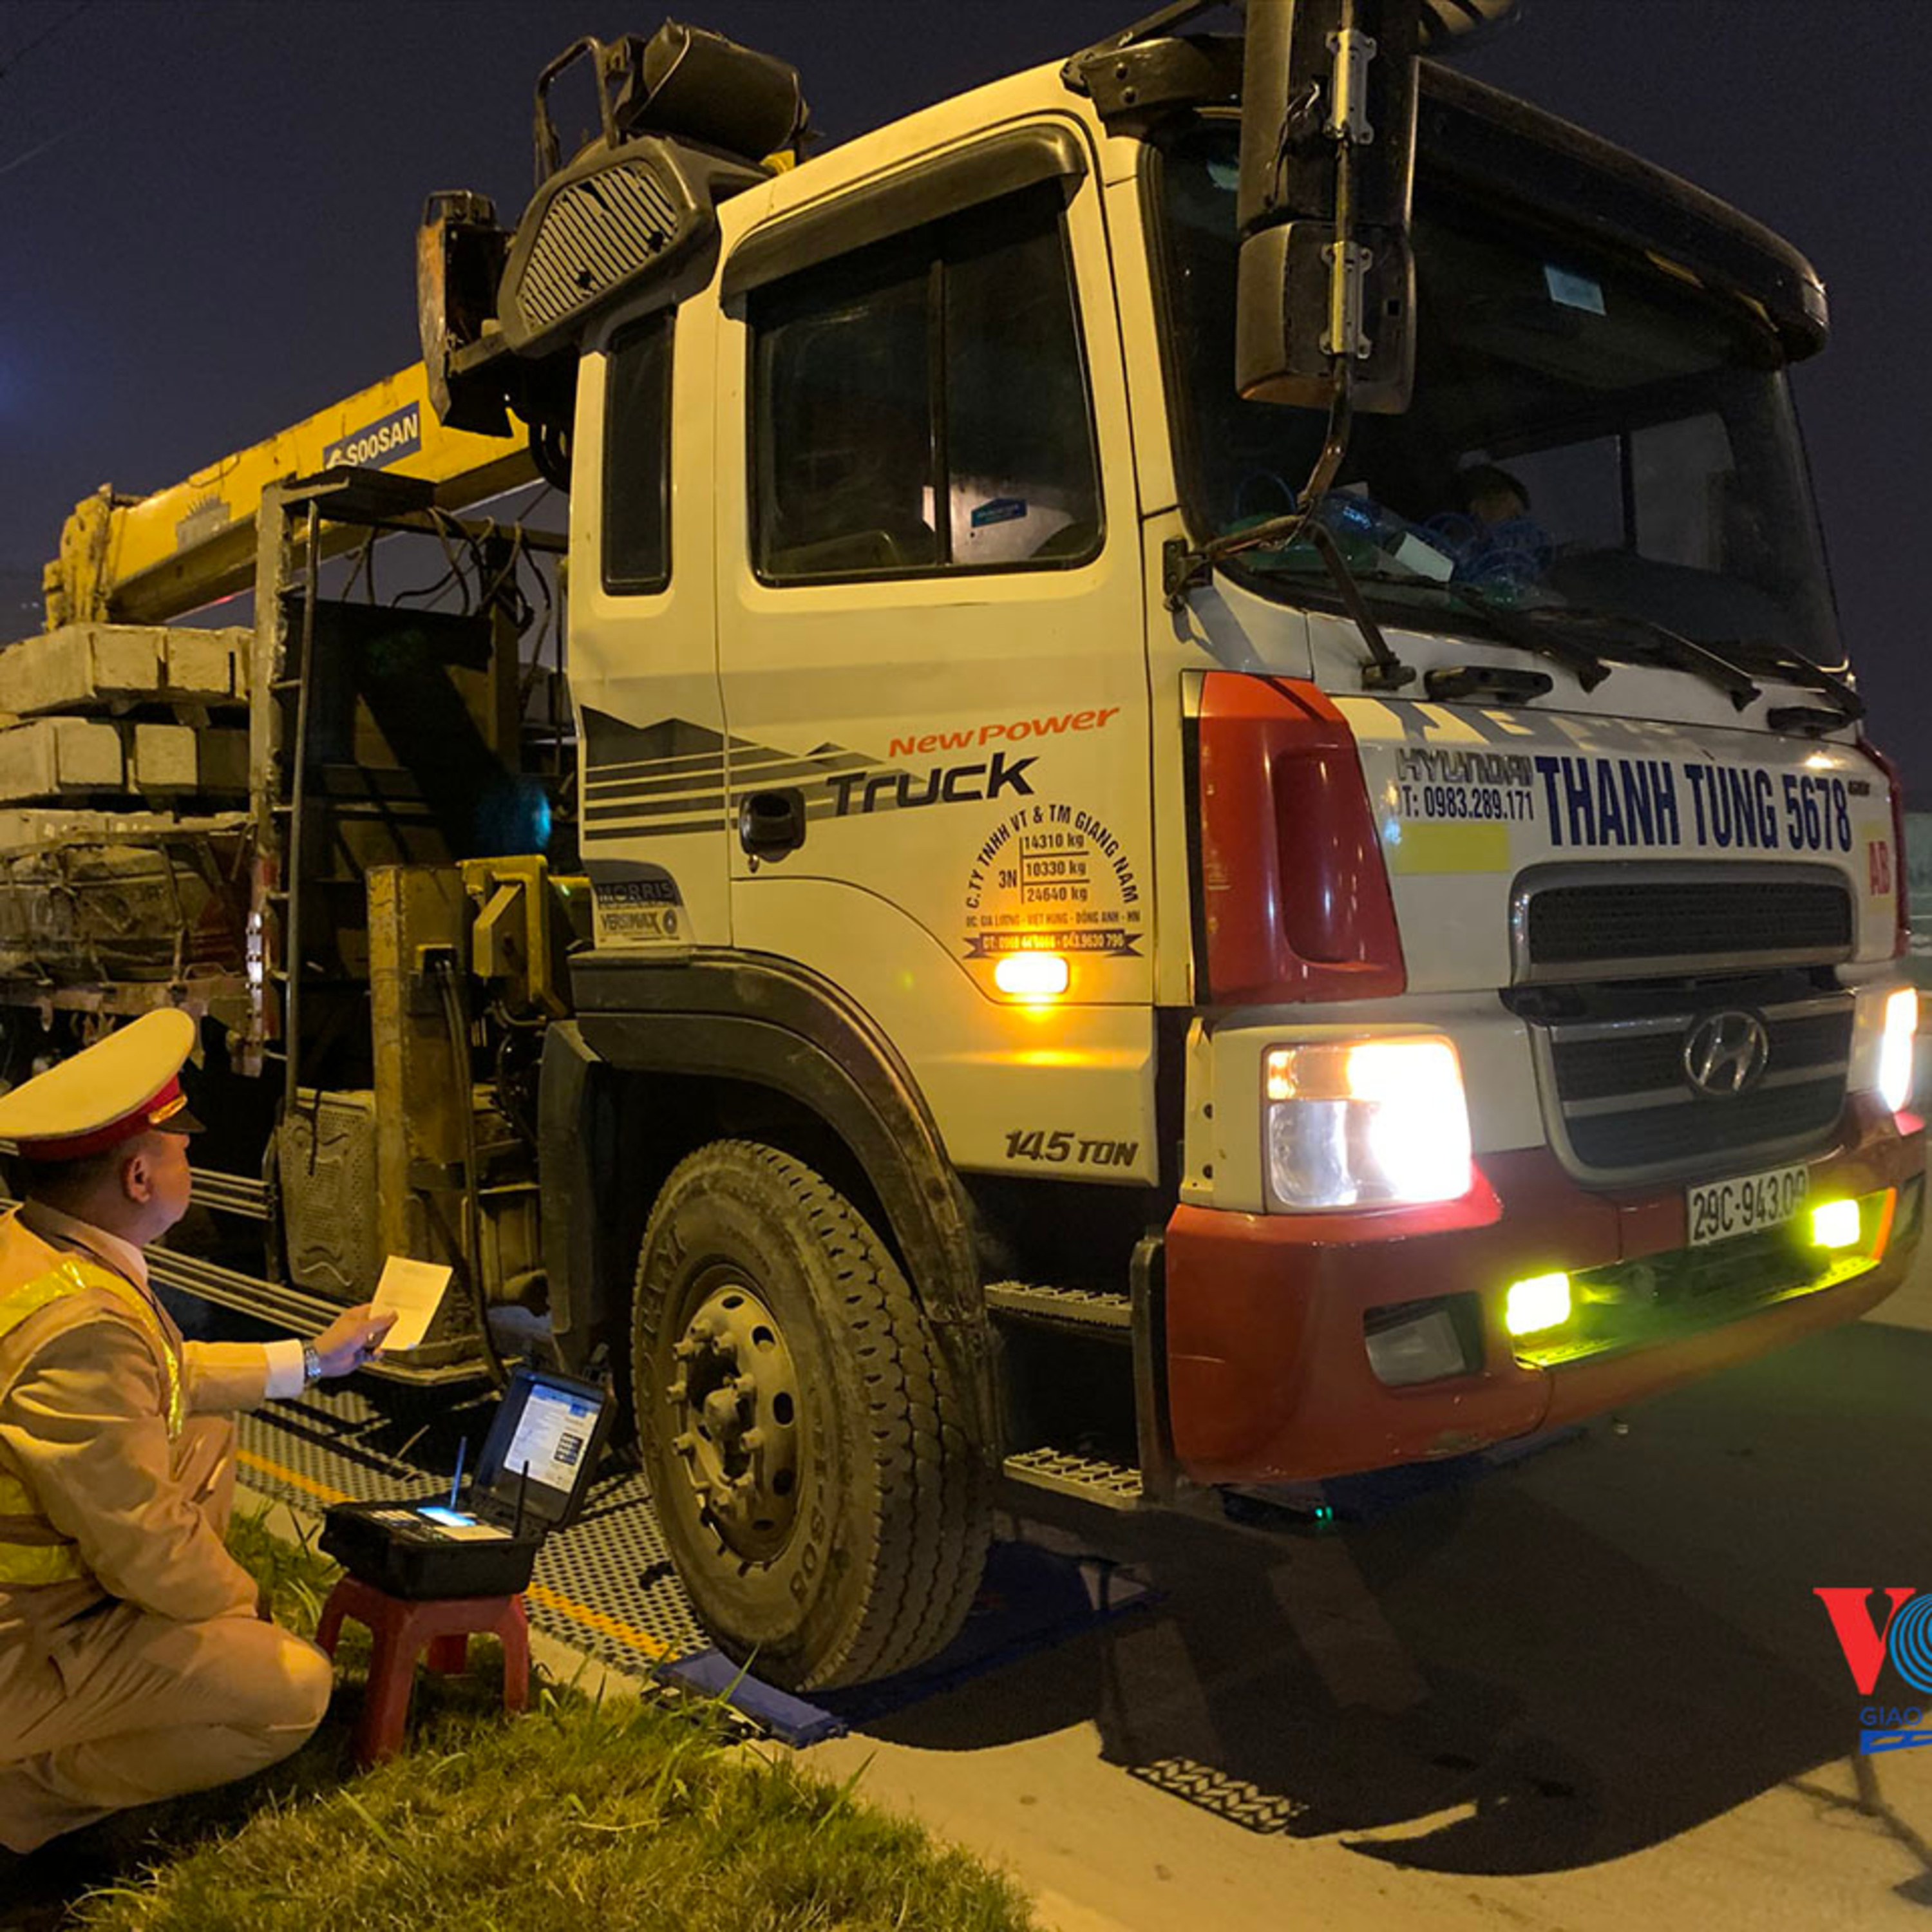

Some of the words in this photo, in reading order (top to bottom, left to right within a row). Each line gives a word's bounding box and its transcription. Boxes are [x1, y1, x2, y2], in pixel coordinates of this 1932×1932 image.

[346, 413, 418, 464] SOOSAN
[1423, 786, 1535, 821] 0983.289.171
[1534, 755, 1681, 846] THANH
[1781, 773, 1853, 853] 5678
[976, 824, 1011, 867] TNHH
[1009, 810, 1028, 832] VT
[1032, 806, 1044, 824] &
[1048, 805, 1072, 824] TM
[1074, 811, 1119, 858] GIANG
[1112, 856, 1139, 904] NAM
[1067, 832, 1084, 849] kg
[1026, 860, 1065, 876] 10330
[1069, 860, 1086, 876] kg
[1070, 886, 1088, 902] kg
[1077, 1139, 1139, 1167] TON
